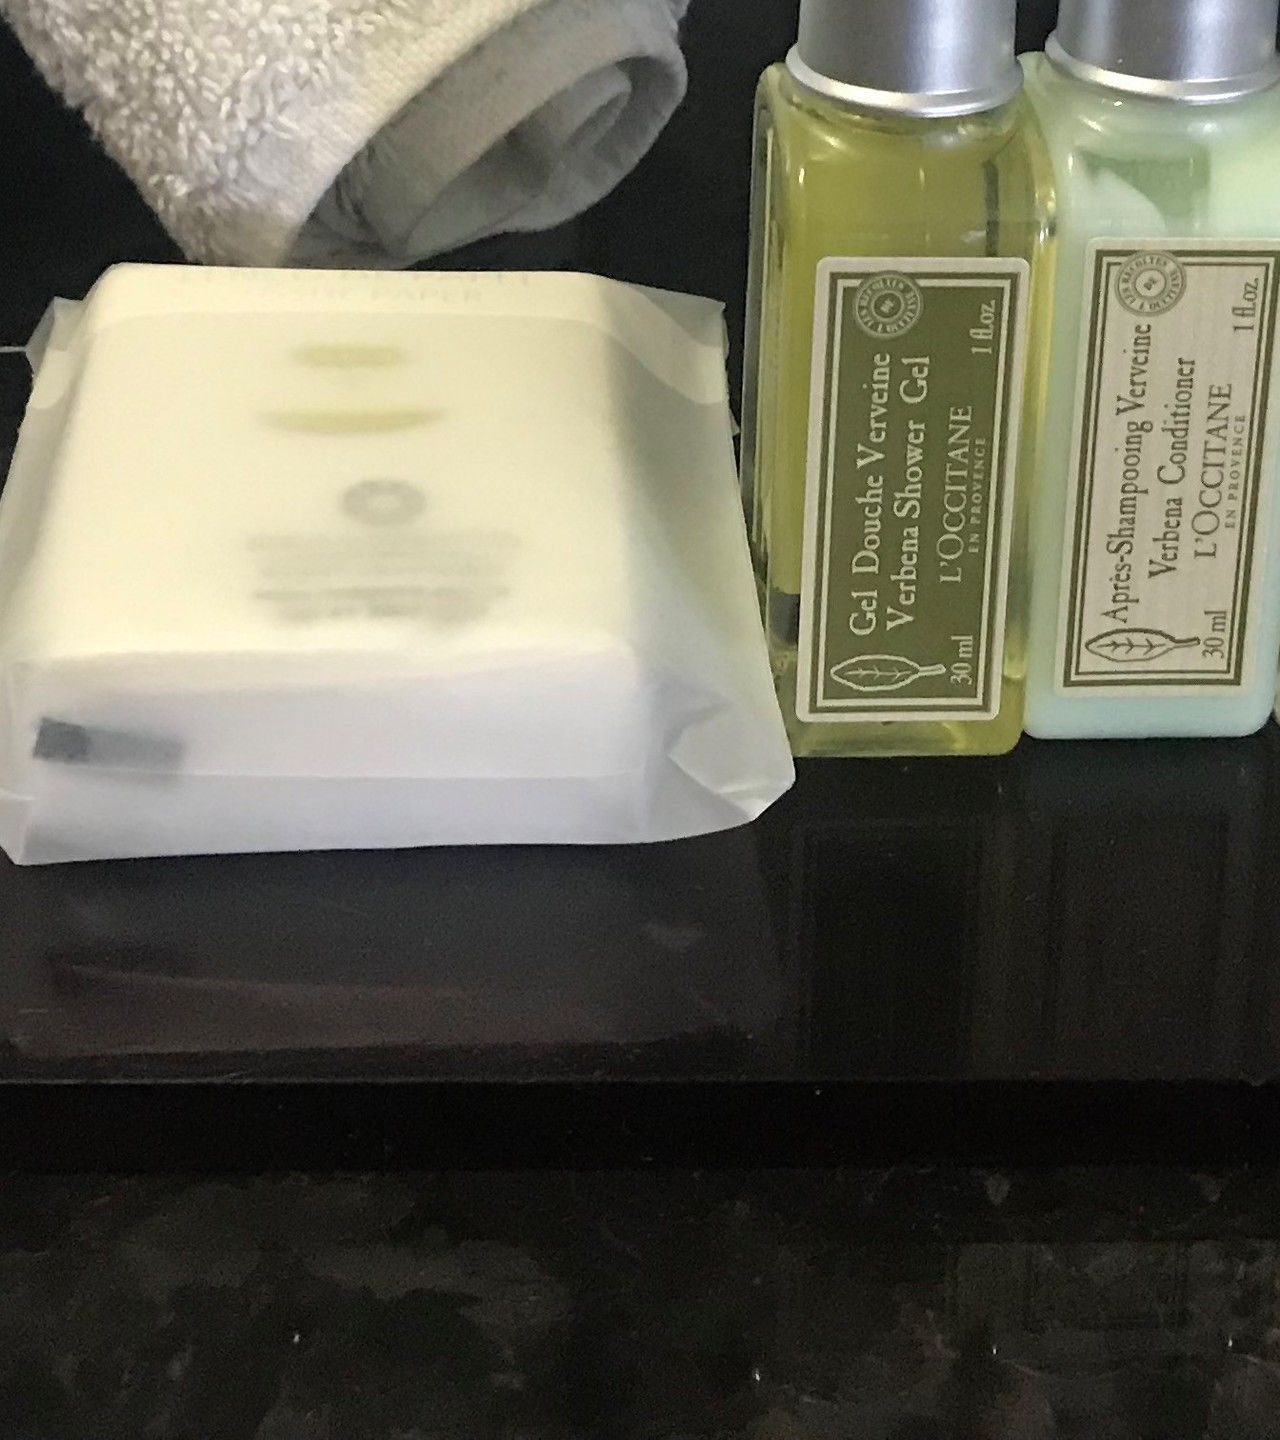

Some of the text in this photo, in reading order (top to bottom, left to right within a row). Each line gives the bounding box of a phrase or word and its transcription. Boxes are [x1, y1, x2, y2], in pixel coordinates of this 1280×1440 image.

[971, 346, 992, 354] 1
[855, 354, 891, 469] Verveine
[1148, 358, 1196, 578] Verbena Conditioner
[852, 475, 883, 573] Douche
[886, 356, 930, 630] Verbena Shower Gel
[936, 406, 972, 582] L'OCCITANE
[969, 438, 986, 553] EN PROVENCE
[1101, 325, 1153, 623] Après-Shampooing Verveine
[1191, 383, 1233, 559] L'OCCITANE
[1224, 415, 1246, 528] EN PROVENCE
[849, 590, 879, 635] Gel
[950, 635, 974, 685] 30 ml
[1204, 610, 1228, 659] 30 ml
